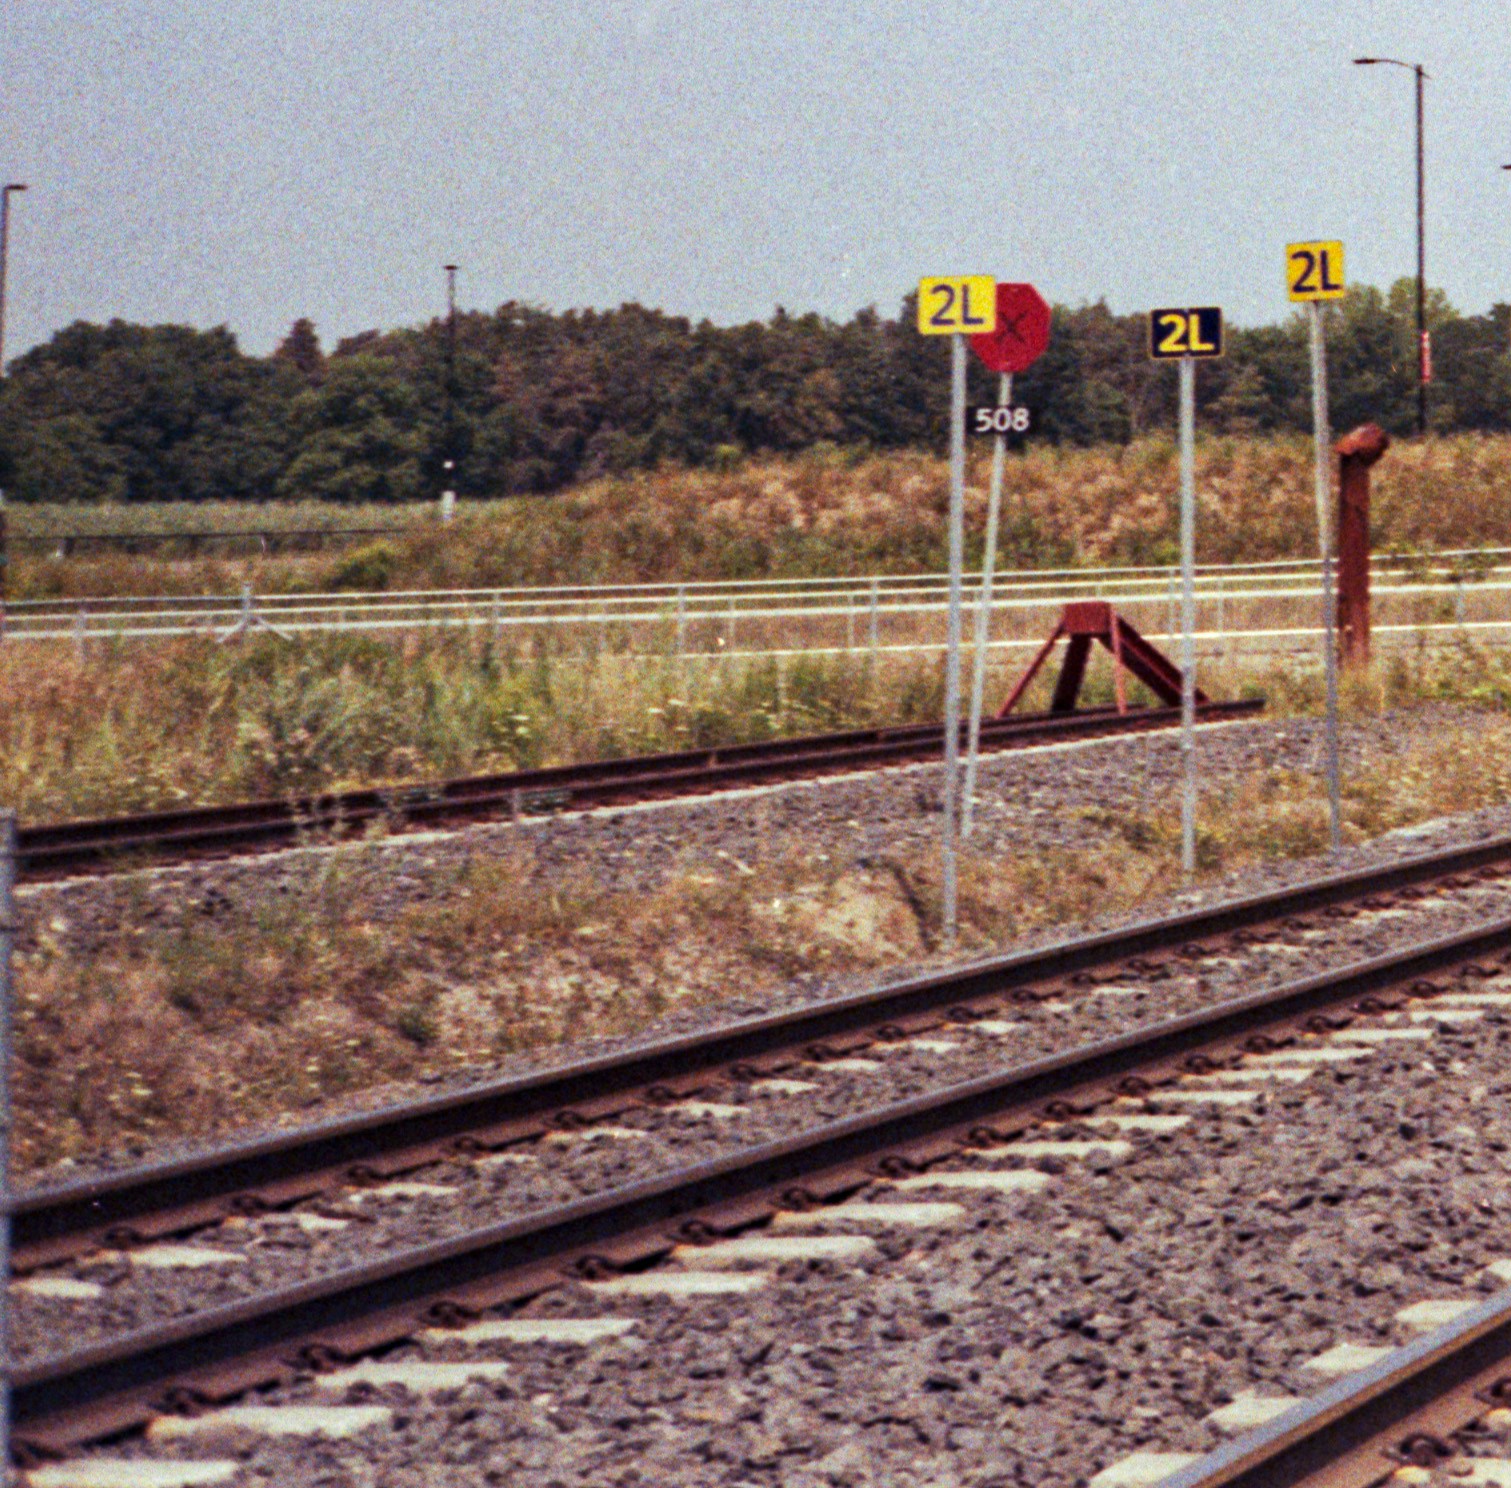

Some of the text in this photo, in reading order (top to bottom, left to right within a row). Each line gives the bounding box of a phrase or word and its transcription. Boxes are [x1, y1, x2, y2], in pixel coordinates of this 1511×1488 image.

[1291, 249, 1342, 293] 2L
[931, 283, 984, 325] 2L
[1158, 313, 1215, 352] 2L
[974, 408, 1030, 431] 508
